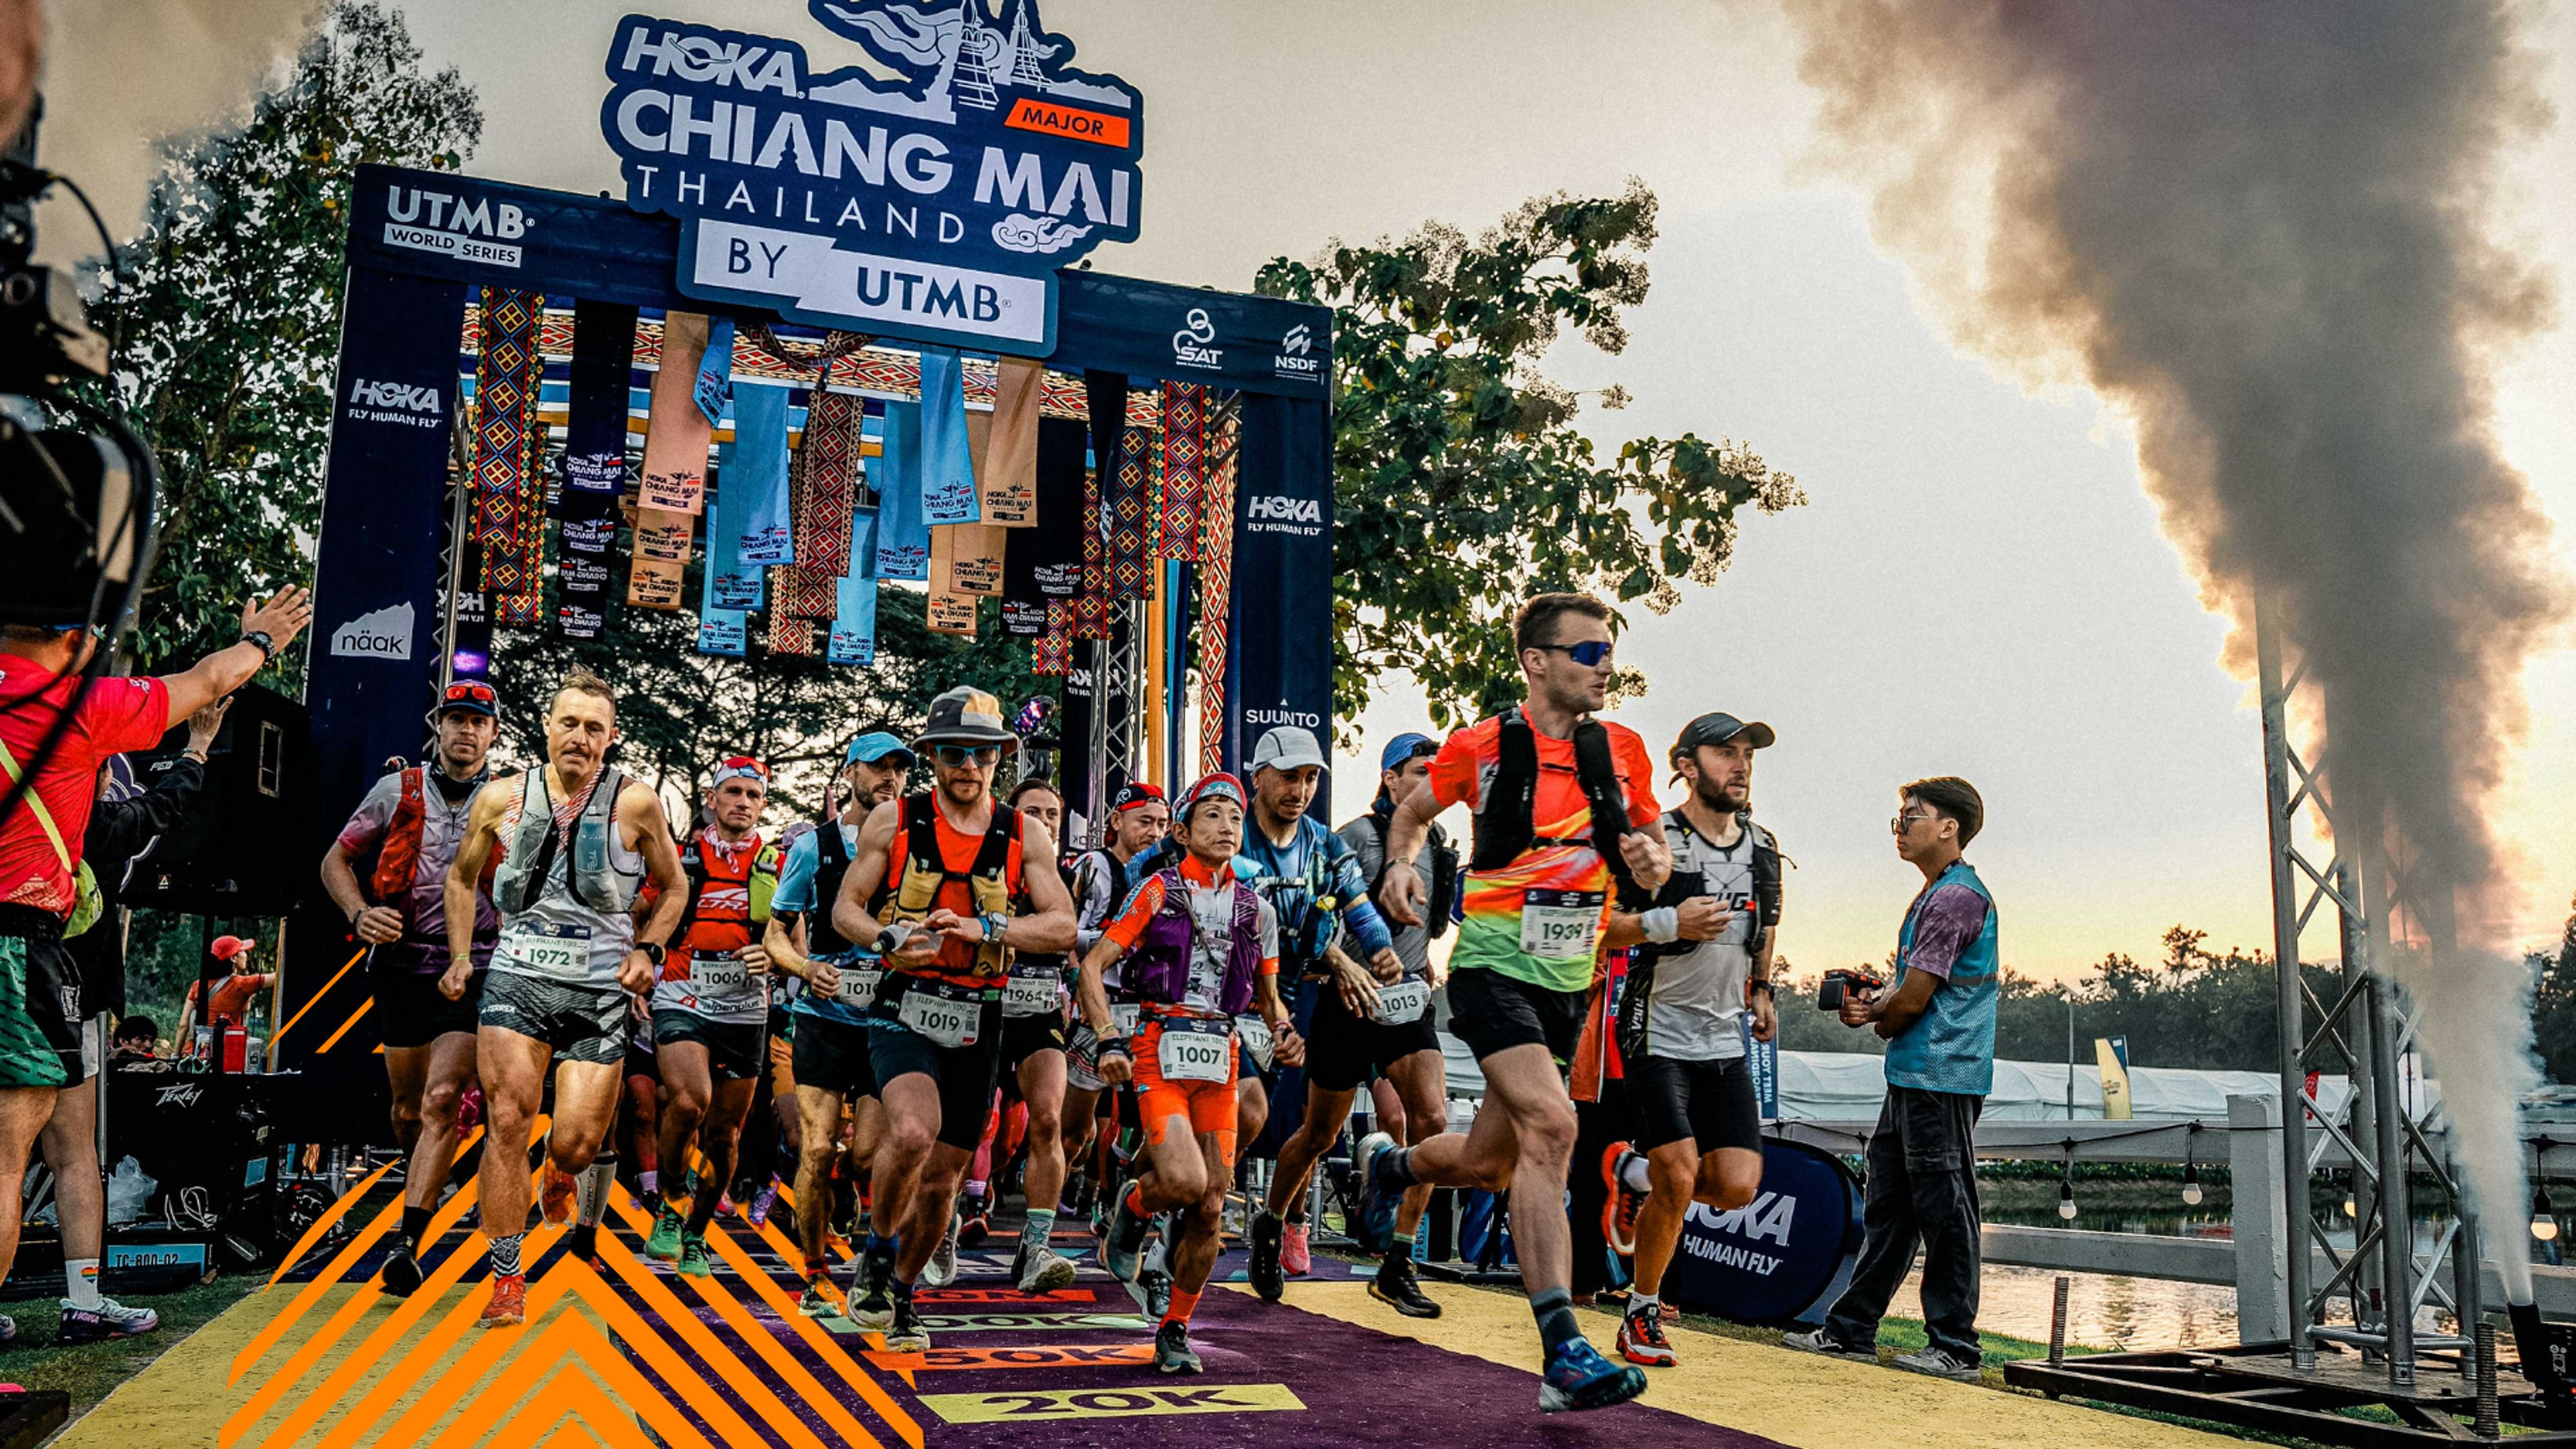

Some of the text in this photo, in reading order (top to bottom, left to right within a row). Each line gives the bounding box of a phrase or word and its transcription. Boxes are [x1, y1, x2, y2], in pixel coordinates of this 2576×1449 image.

[621, 27, 798, 98] HOKA
[1022, 106, 1104, 137] MAJOR
[616, 88, 1130, 227] CHIANG MAI
[637, 165, 965, 243] THAILAND
[391, 228, 516, 263] WORLD SERIES
[728, 238, 788, 279] BY
[1177, 346, 1223, 365] SAT
[1274, 355, 1318, 372] NSDF
[350, 379, 440, 413] HOKA
[348, 409, 439, 429] FLY HUMAN FLY
[1248, 496, 1321, 523] HOKA
[1247, 522, 1321, 536] FLY HUMAN FLY
[341, 629, 403, 654] näak
[1245, 709, 1320, 728] SUUNTO
[1543, 923, 1583, 940] 1939
[529, 949, 570, 966] 1972
[705, 972, 741, 985] 1006
[1009, 989, 1043, 1003] 1964
[1383, 994, 1418, 1012] 1013
[920, 1010, 960, 1032] 1019
[1171, 1034, 1209, 1043] ELEPHANT
[1177, 1046, 1221, 1065] 1007
[1683, 1234, 1781, 1276] HUMAN FLY
[72, 1310, 100, 1325] HOKA
[925, 1347, 1150, 1367] 50K
[981, 1388, 1263, 1416] 20K
